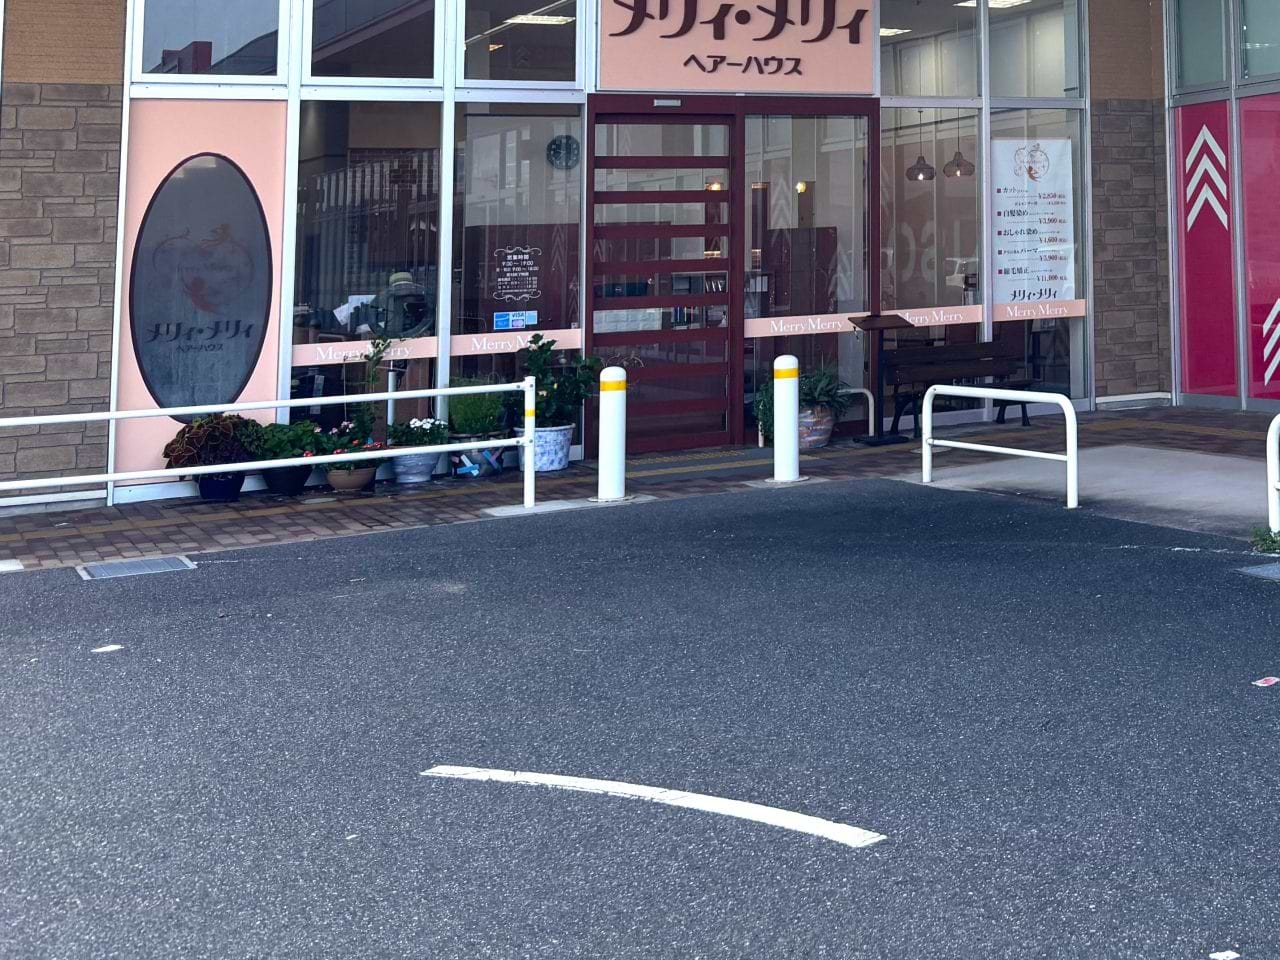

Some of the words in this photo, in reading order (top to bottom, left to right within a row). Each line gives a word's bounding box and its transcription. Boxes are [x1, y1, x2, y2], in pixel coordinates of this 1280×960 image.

[683, 54, 803, 76] ヘアーハウス
[931, 309, 963, 322] Merry
[1006, 305, 1037, 318] Merry
[1038, 303, 1068, 316] Merry
[770, 319, 807, 334] Merry
[808, 317, 843, 330] Merry
[472, 336, 514, 351] Merry
